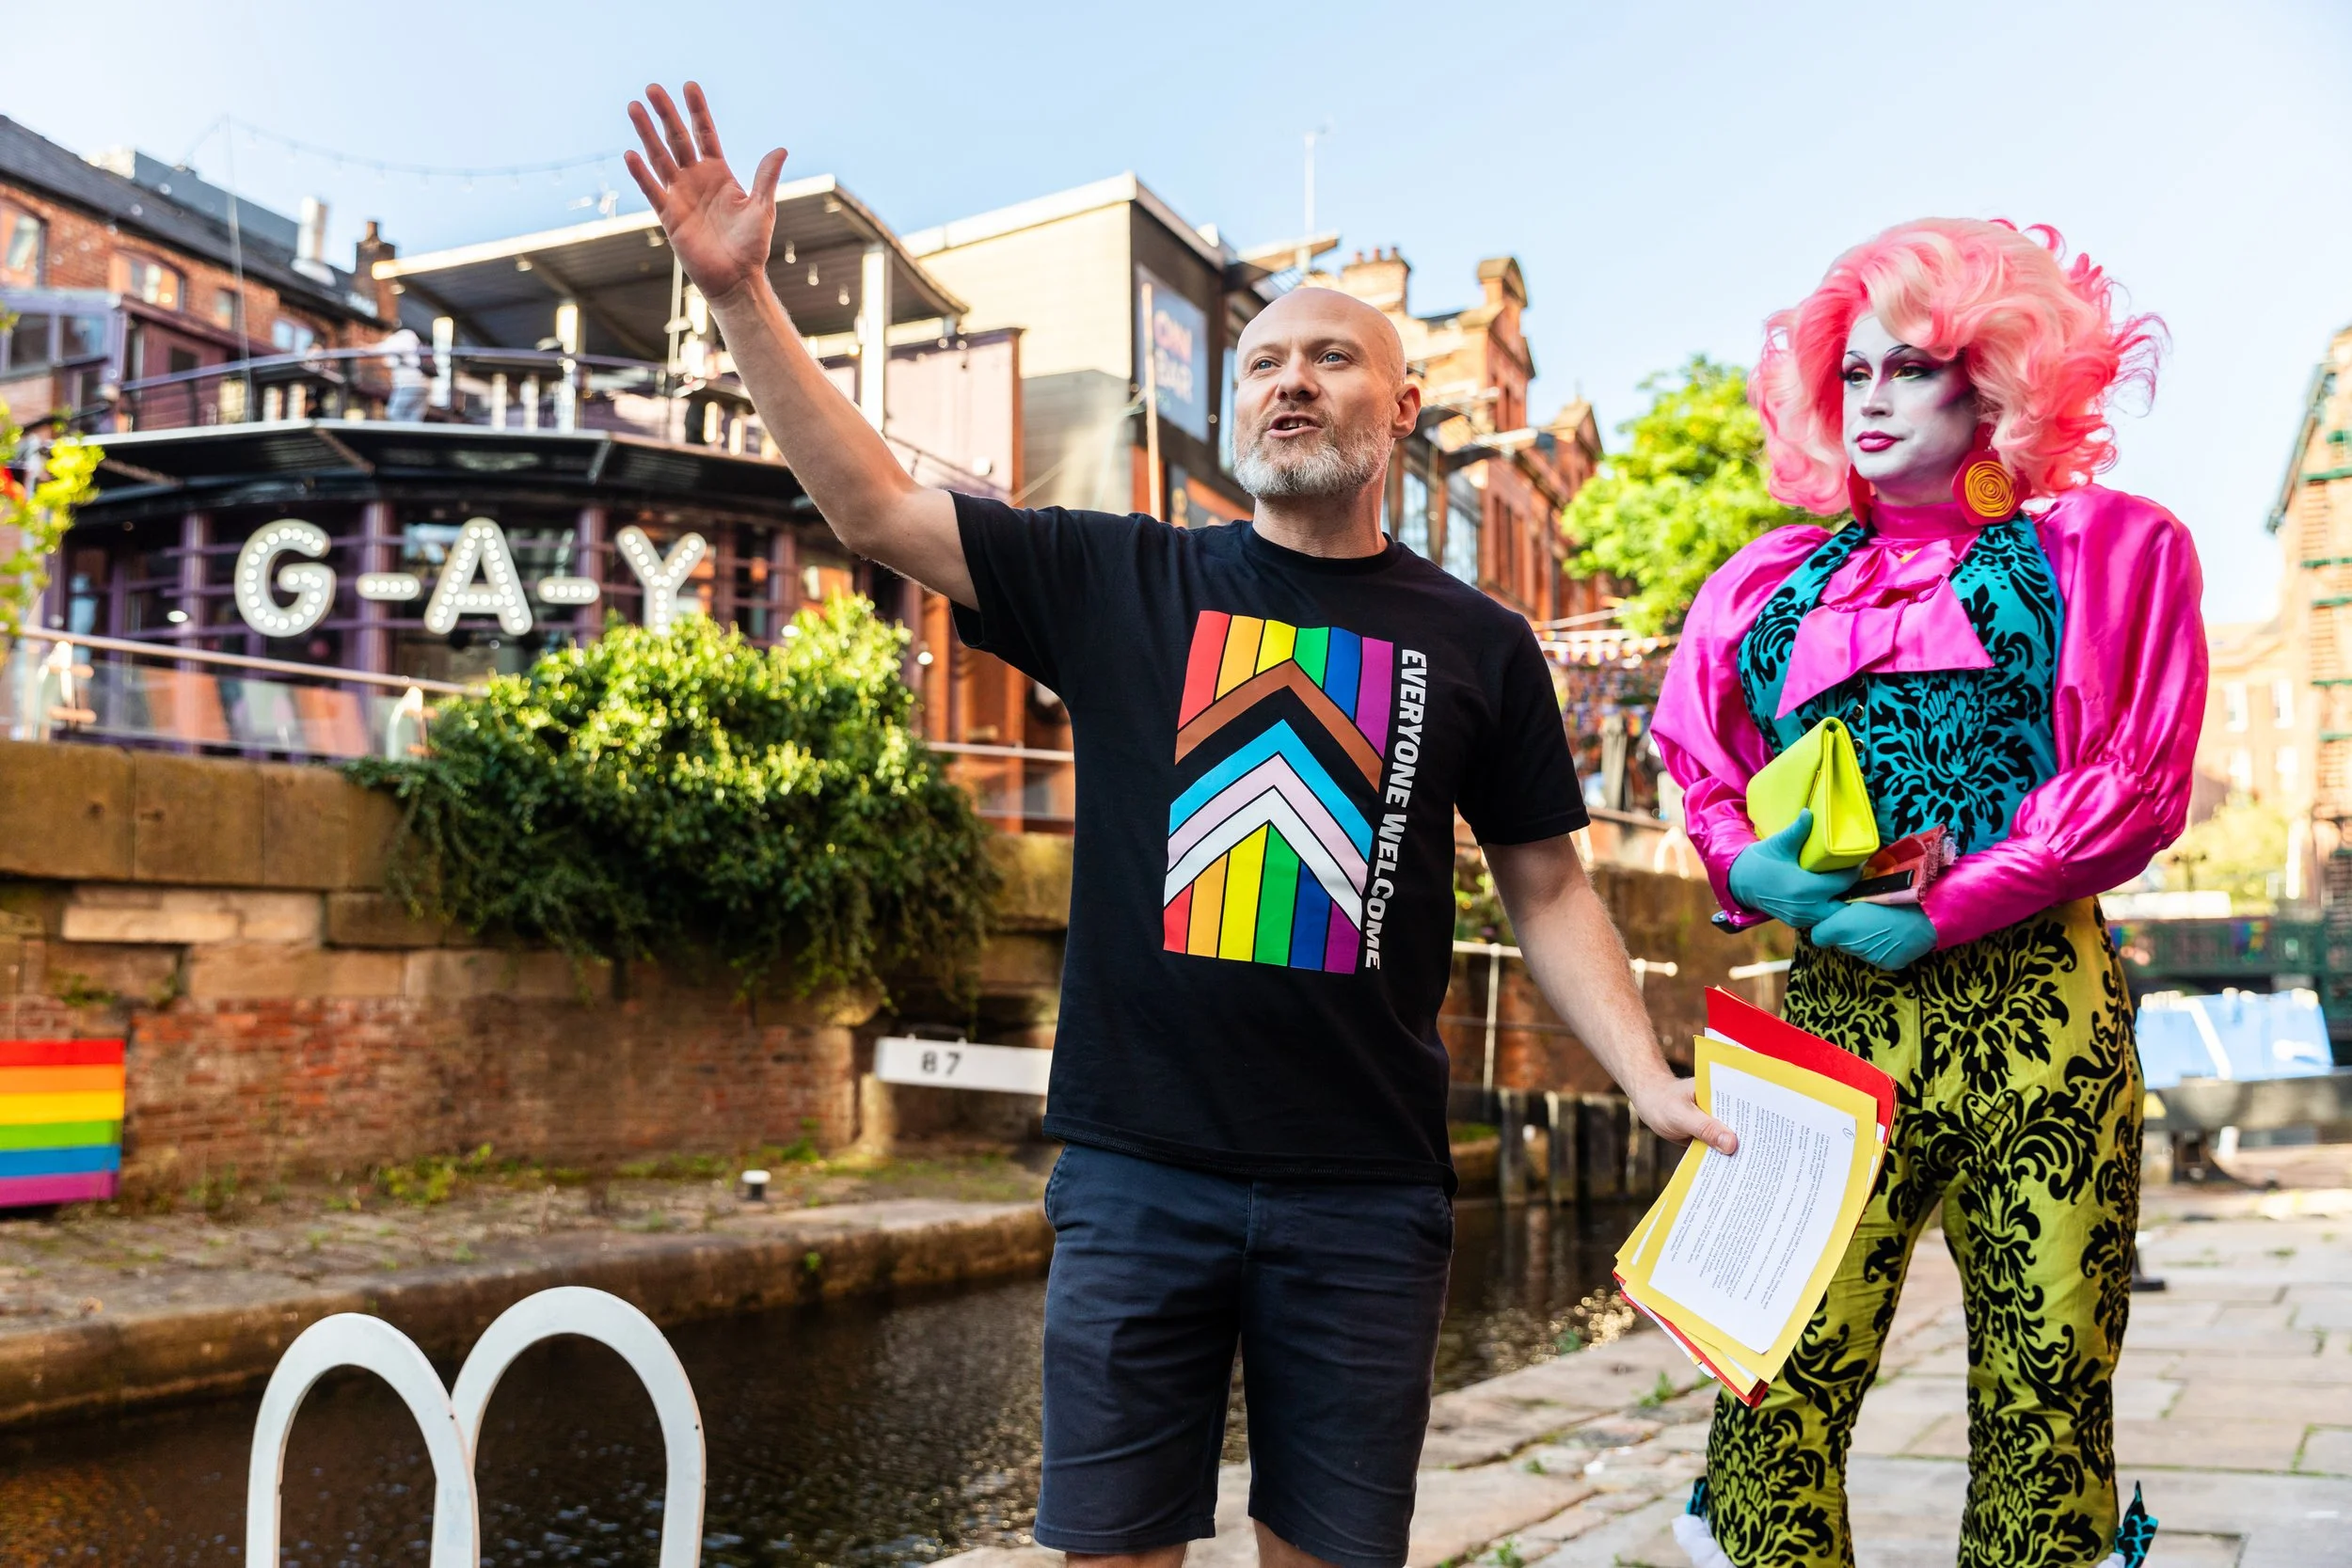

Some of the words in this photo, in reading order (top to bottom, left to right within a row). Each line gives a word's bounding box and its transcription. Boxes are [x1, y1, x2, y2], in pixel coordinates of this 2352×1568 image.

[234, 516, 707, 638] G-A-Y
[1385, 649, 1427, 808] EVERYONE
[1365, 813, 1407, 970] WELCOME
[921, 1050, 961, 1076] 87
